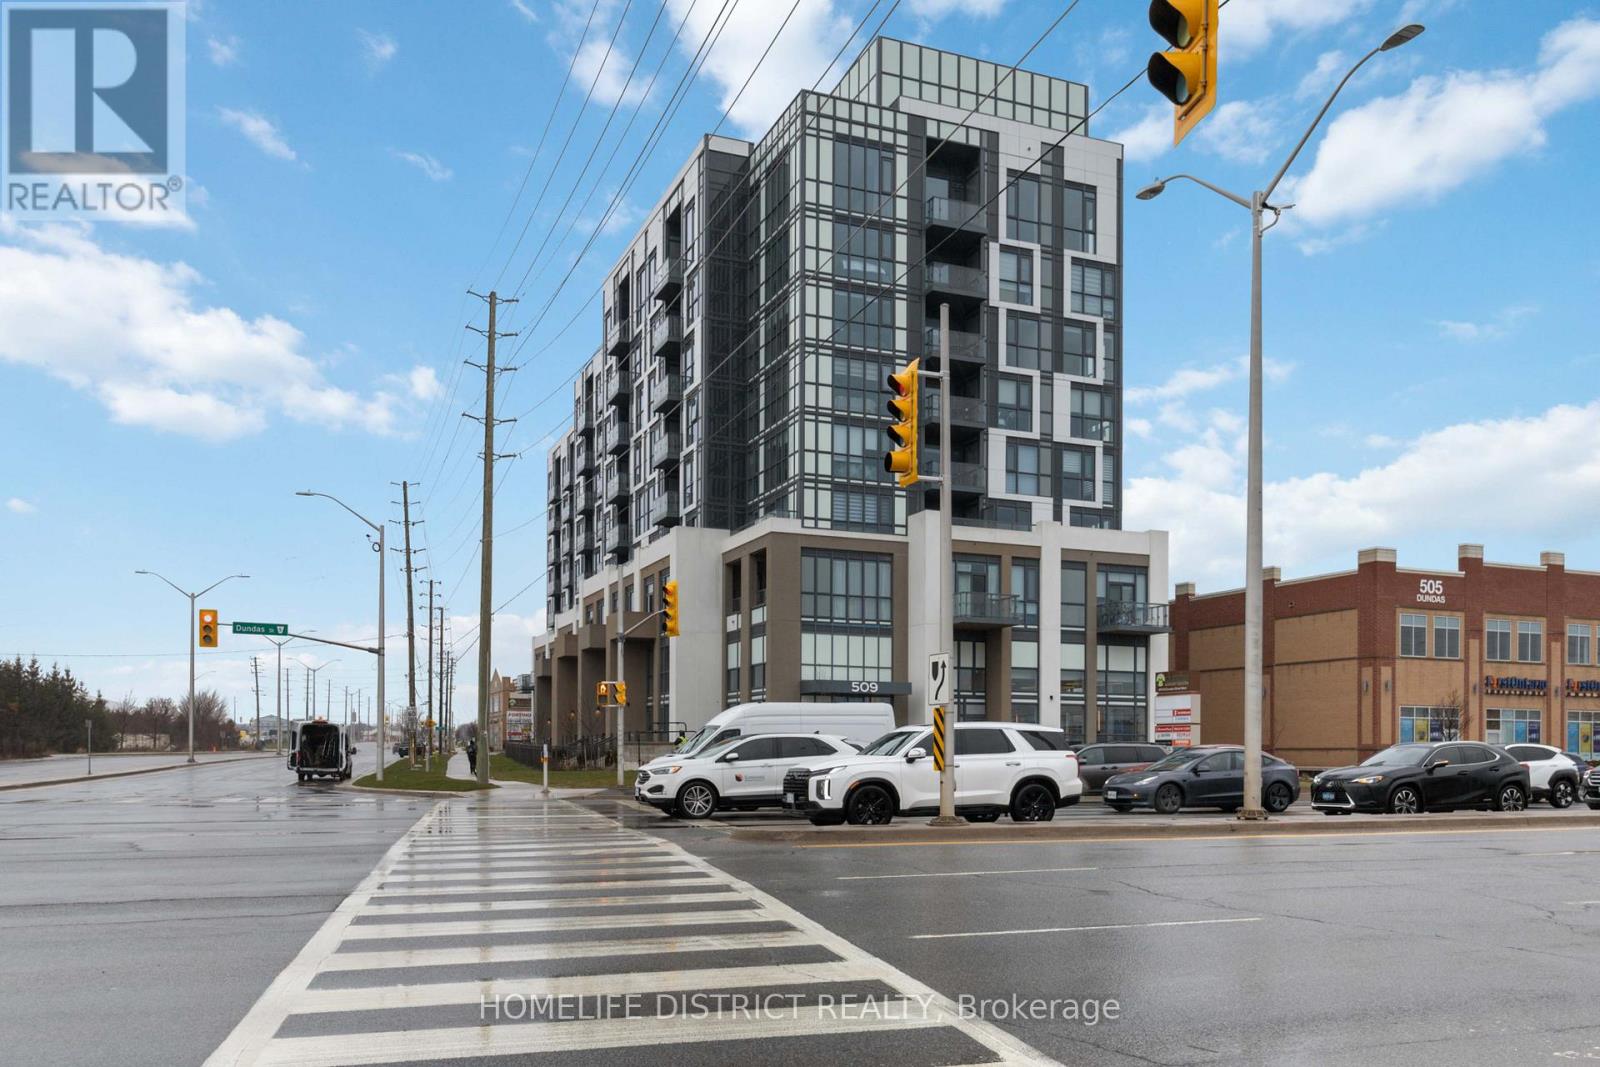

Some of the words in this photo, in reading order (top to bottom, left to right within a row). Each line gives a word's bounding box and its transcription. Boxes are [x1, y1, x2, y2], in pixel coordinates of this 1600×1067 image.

[1419, 579, 1444, 595] 505
[1416, 593, 1446, 604] DUNDAS
[235, 624, 265, 633] Dundas
[851, 681, 879, 693] 509
